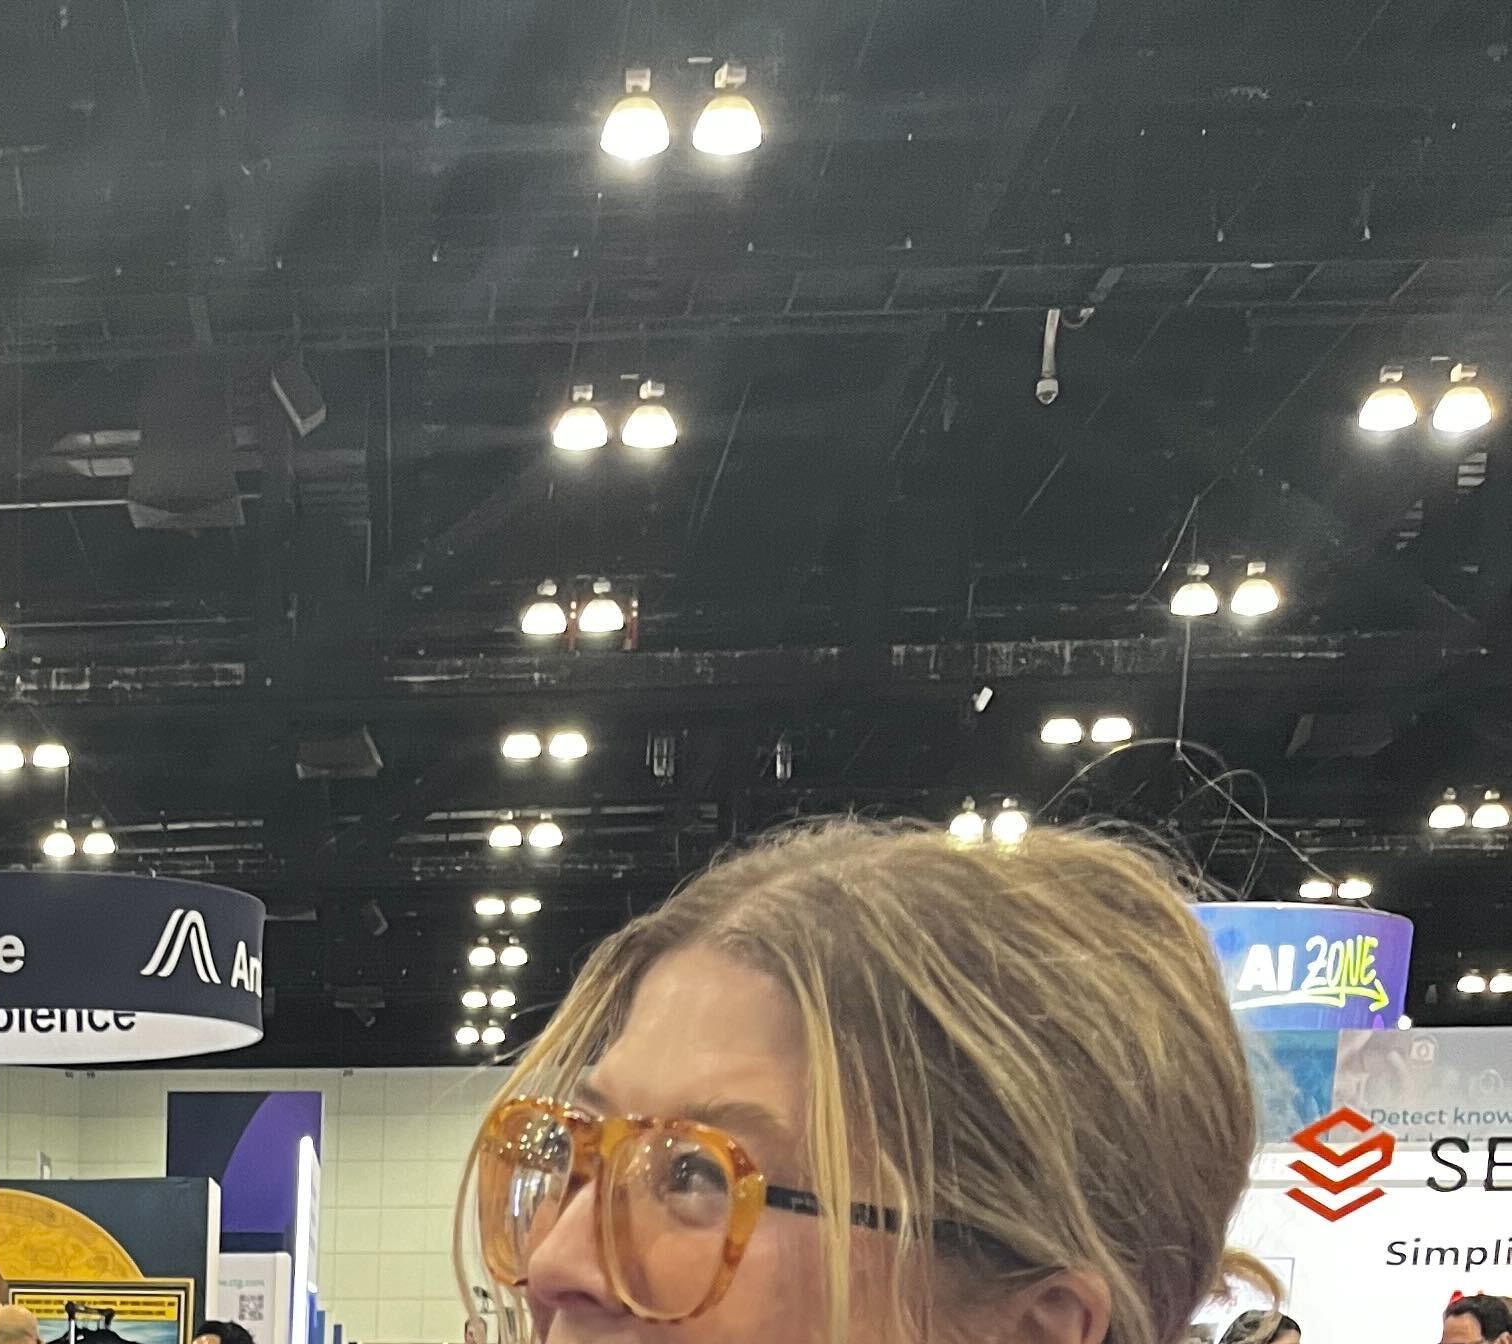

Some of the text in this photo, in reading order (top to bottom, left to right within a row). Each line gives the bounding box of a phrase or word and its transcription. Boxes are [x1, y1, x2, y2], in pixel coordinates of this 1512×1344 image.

[1236, 934, 1380, 1000] AI ZONE
[1370, 1109, 1445, 1125] Detect
[1426, 1137, 1512, 1192] SE
